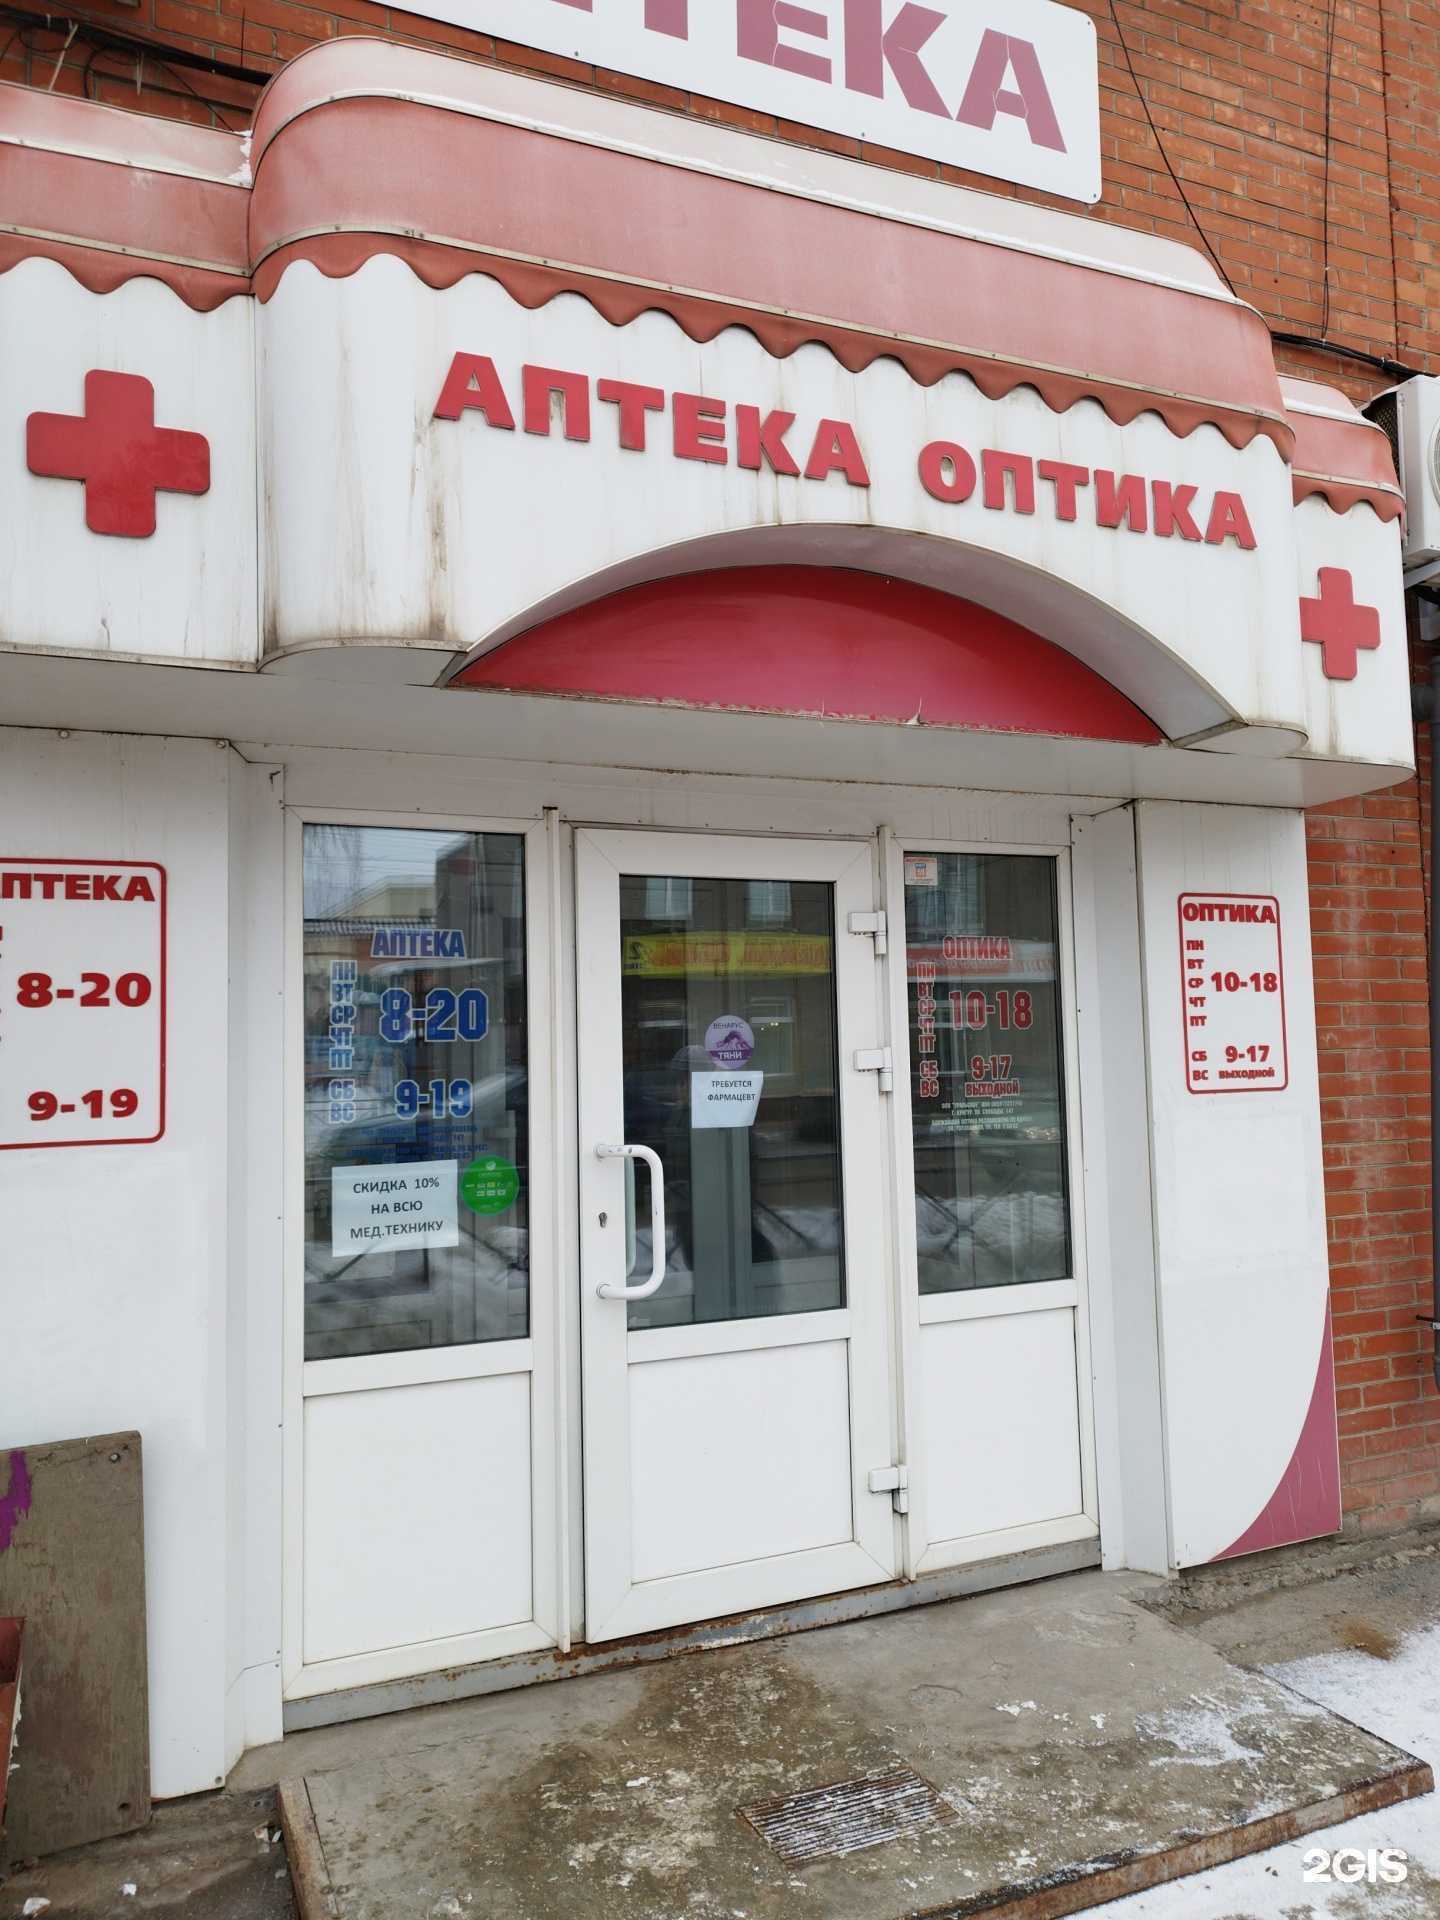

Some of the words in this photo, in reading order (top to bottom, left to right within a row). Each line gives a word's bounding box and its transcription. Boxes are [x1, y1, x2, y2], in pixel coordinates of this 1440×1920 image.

[434, 351, 870, 487] АПТЕКА
[917, 440, 1259, 550] ОПТИКА
[0, 872, 155, 901] ПТЕКА
[1182, 903, 1276, 924] ОПТИКА
[371, 929, 466, 959] АПТЕКА
[943, 936, 1011, 960] ОПТИКА
[1186, 940, 1204, 950] ПН
[917, 962, 936, 979] ПН
[1187, 959, 1204, 969] ВТ
[17, 973, 152, 1008] 8-20
[917, 981, 934, 997] ВТ
[1188, 977, 1204, 989] СР
[1211, 972, 1278, 992] 10-18
[331, 982, 354, 1003] ВТ
[1189, 996, 1206, 1007] ЧТ
[330, 1004, 356, 1025] СР
[379, 988, 488, 1042] 8-20
[918, 999, 936, 1016] СР
[949, 990, 1033, 1030] 10-18
[918, 1017, 936, 1034] ЧТ
[1190, 1015, 1207, 1026] ПТ
[919, 1035, 936, 1053] ПТ
[718, 1051, 742, 1060] ТЯНИ
[1191, 1051, 1207, 1062] СБ
[1225, 1045, 1270, 1063] 9-17
[920, 1061, 938, 1078] СБ
[971, 1055, 1012, 1081] 9-17
[1192, 1070, 1209, 1081] ВС
[712, 1080, 752, 1088] ТРЕБУЕТСЯ
[920, 1079, 939, 1097] ВС
[965, 1079, 1020, 1098] ВЫХОДНОЙ
[28, 1089, 138, 1121] 9-19
[395, 1079, 472, 1119] 9-19
[707, 1093, 757, 1102] ФАРМАЦЕВТ
[329, 1101, 356, 1124] ВС
[353, 1180, 408, 1194] СКИДКА
[415, 1176, 440, 1190] 10%
[371, 1203, 389, 1215] НА
[393, 1200, 423, 1213] ВСЮ
[350, 1220, 444, 1239] МЕД.ТЕХНИКУ
